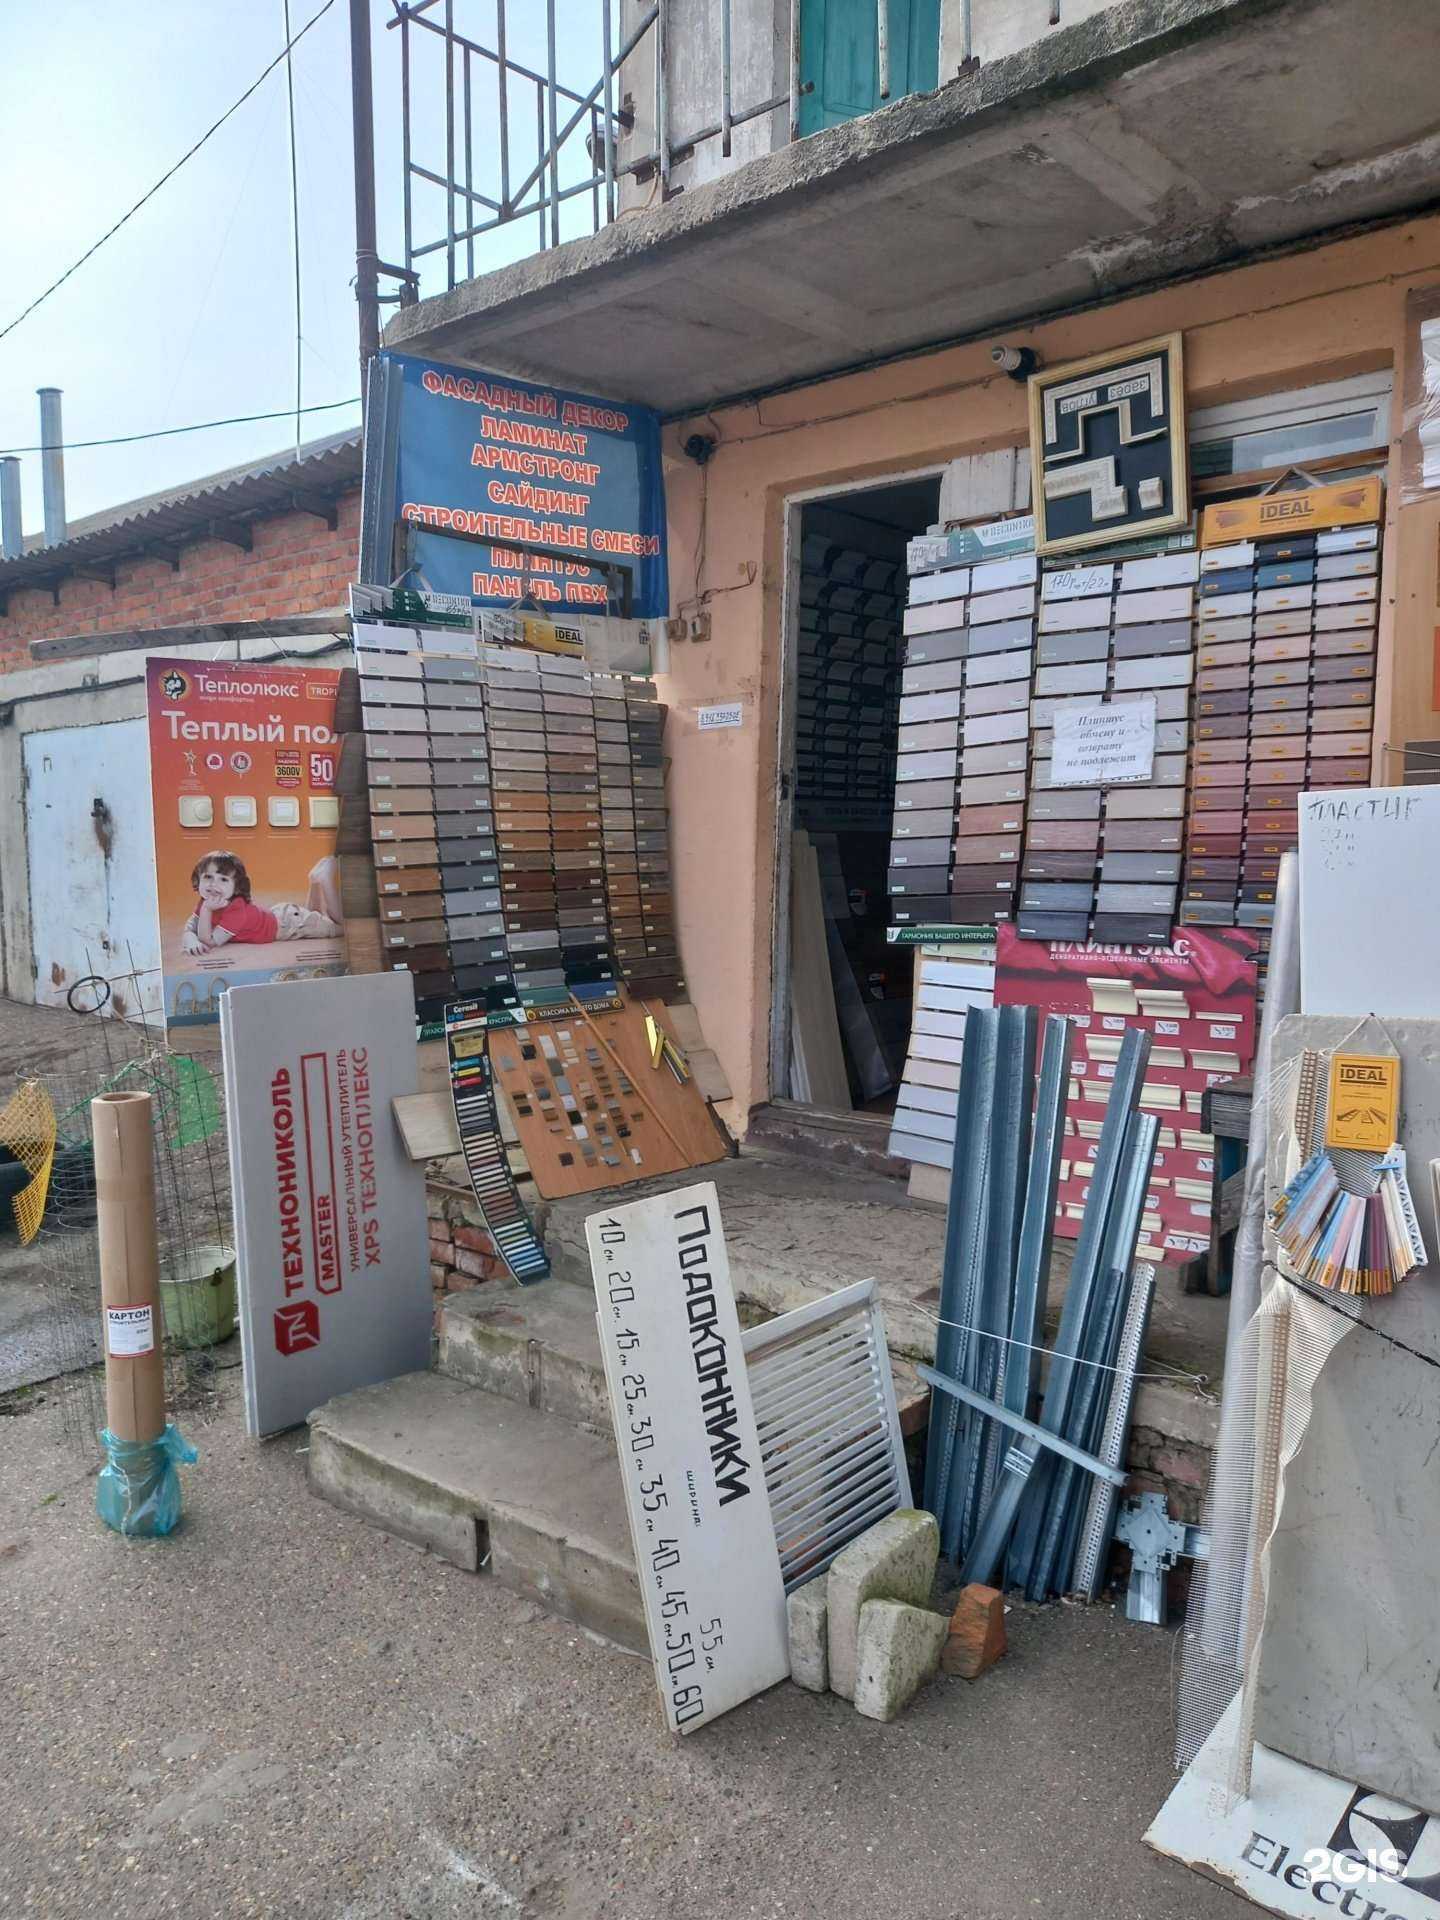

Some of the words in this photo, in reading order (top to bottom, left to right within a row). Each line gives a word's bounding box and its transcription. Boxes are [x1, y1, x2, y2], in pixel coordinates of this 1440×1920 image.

[423, 371, 557, 418] ФАСАДНЫЙ
[562, 403, 629, 432] ДЕКОР
[480, 415, 587, 456] ЛАМИНАТ
[471, 444, 600, 487] АРМСТРОНГ
[487, 480, 590, 516] САЙДИНГ
[1260, 500, 1314, 519] IDEAL
[402, 503, 588, 549] СТРОИТЕЛЬНЫЕ
[591, 529, 660, 557] СМЕСИ
[472, 573, 561, 603] ПАНЛЬ
[566, 583, 608, 606] ПВХ
[555, 628, 583, 642] IDEAL
[194, 674, 300, 698] Теплолюкс
[311, 686, 337, 697] TROPI
[161, 710, 285, 743] Теплый
[311, 753, 333, 782] 50
[1080, 754, 1136, 766] подлежит
[935, 931, 960, 940] ВАШЕГО
[961, 931, 995, 940] ИНТЕРЬЕРА
[1149, 956, 1189, 965] ЭЛЕМЕНТЫ
[1340, 1068, 1387, 1081] IDEAL
[336, 1048, 352, 1142] УТЕПЛИТЕЛЬ
[352, 1047, 377, 1214] ТЕХНОПЛЕКС
[272, 1067, 304, 1297] ТЕХНОНИКОЛЬ
[341, 1145, 361, 1272] УНИВЕРСАЛЬНЫЙ
[317, 1194, 334, 1280] MASTER
[363, 1218, 381, 1267] XPS
[599, 1218, 626, 1244] 10
[608, 1271, 635, 1304] 20
[109, 1308, 150, 1320] КАРТОН
[616, 1328, 640, 1350] 15
[674, 1205, 750, 1507] ПОДОКОННИКИ
[622, 1374, 647, 1400] 25
[631, 1416, 654, 1452] 30
[639, 1474, 668, 1512] 35
[651, 1539, 681, 1572] 40
[662, 1590, 689, 1619] 45
[700, 1618, 723, 1651] 55
[666, 1632, 696, 1673] 50
[673, 1685, 704, 1725] 60
[1241, 1830, 1411, 1920] Electr
